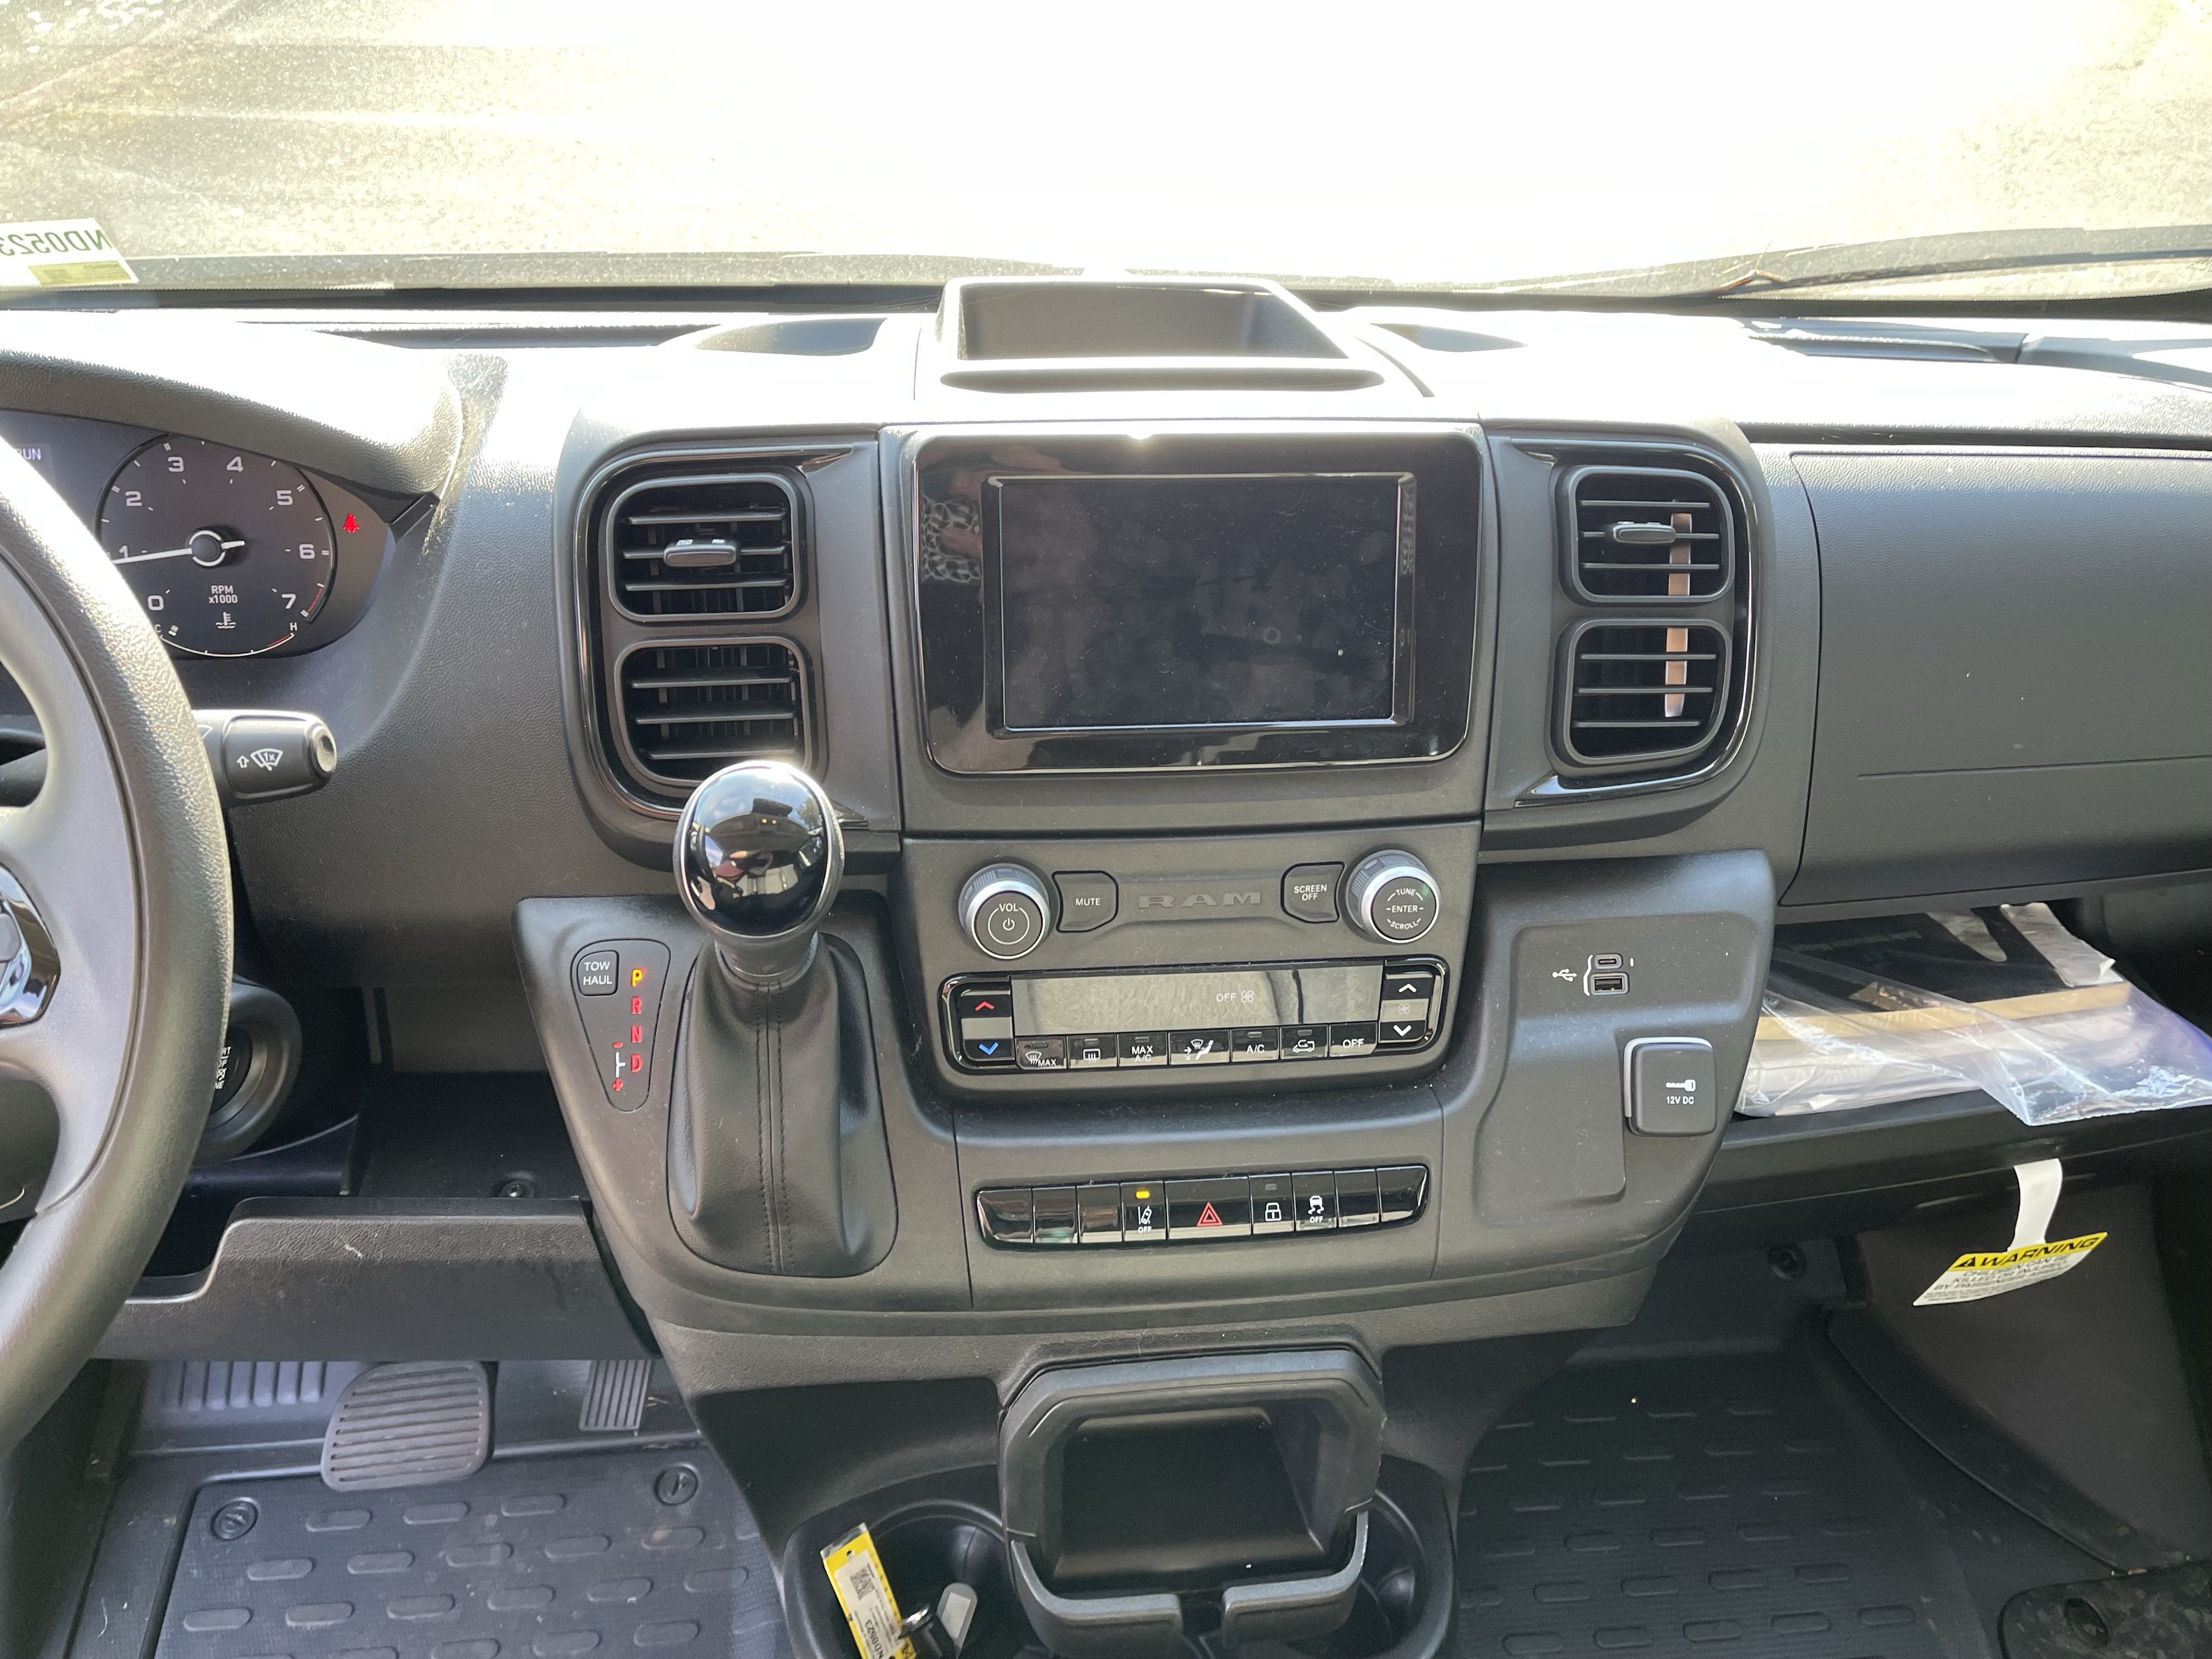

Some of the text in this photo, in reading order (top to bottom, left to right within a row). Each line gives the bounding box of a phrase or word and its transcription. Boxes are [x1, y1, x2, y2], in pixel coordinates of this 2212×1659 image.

[168, 457, 184, 471] 3
[227, 456, 243, 472] 4
[125, 490, 142, 506] 2
[276, 490, 293, 505] 5
[119, 545, 128, 558] 1
[299, 544, 315, 560] 6
[211, 585, 234, 594] RPM
[148, 595, 164, 611] 0
[208, 595, 238, 604] x1000
[281, 594, 296, 609] 7
[290, 622, 297, 631] H
[1294, 884, 1327, 894] SCREEN
[1396, 887, 1417, 897] TUNE
[1075, 898, 1101, 906] MUTE
[1138, 892, 1261, 909] RAM
[1301, 893, 1318, 901] OFF
[998, 902, 1019, 912] VOL
[1391, 905, 1418, 913] ENTER
[1389, 920, 1419, 930] SCROLL
[584, 961, 611, 971] TOW
[583, 975, 613, 986] HAUL
[631, 968, 644, 988] P
[1216, 992, 1237, 1002] OFF
[631, 996, 642, 1014] R
[631, 1024, 642, 1043] N
[1342, 1039, 1364, 1048] OFF
[1131, 1045, 1153, 1055] MAX
[1246, 1044, 1265, 1054] A/C
[631, 1053, 643, 1073] D
[1038, 1058, 1057, 1067] MAX
[1135, 1054, 1152, 1063] A/C
[1666, 1096, 1694, 1105] 12V DC
[1979, 1237, 2099, 1266] WARNING
